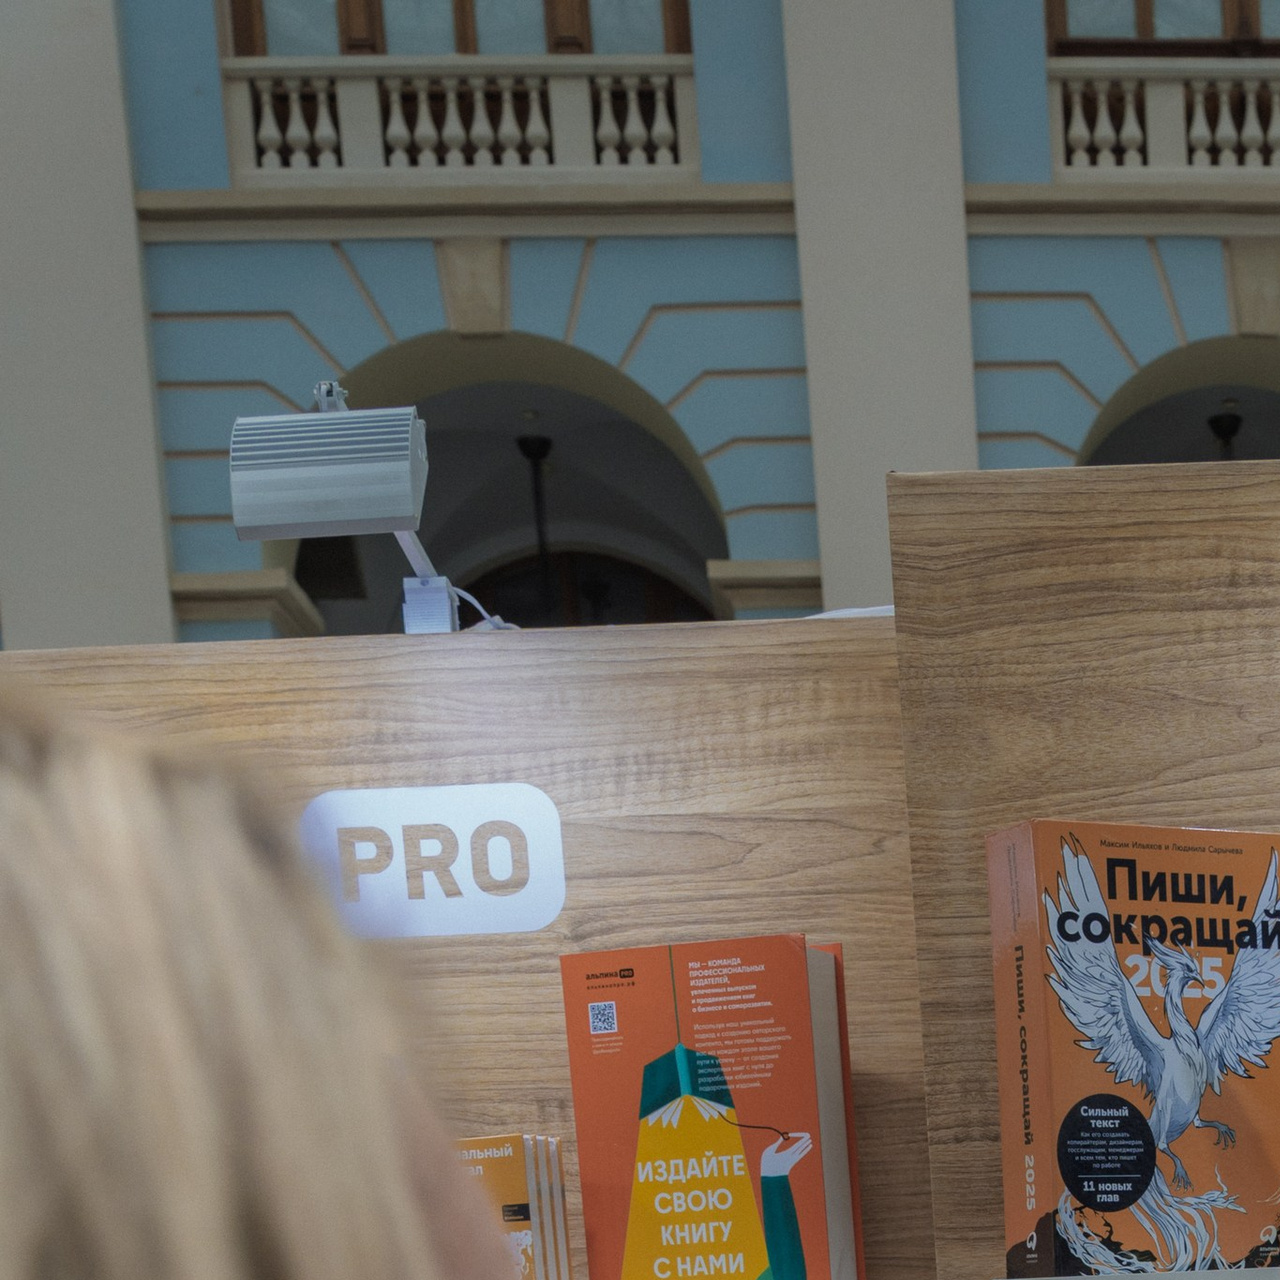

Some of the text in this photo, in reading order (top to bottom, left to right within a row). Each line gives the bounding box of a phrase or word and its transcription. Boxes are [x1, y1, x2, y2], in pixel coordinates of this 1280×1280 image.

[1100, 839, 1129, 848] Максим
[1132, 841, 1162, 850] Ильяхов
[1172, 844, 1206, 853] Людмила
[1208, 846, 1243, 856] Сарычева
[337, 820, 531, 902] PRO
[1106, 858, 1247, 911] Пиши,
[1014, 945, 1025, 1020] Пиши,
[1019, 1025, 1034, 1145] сокращай
[1080, 1106, 1129, 1116] Сильный
[1090, 1120, 1120, 1128] текст
[637, 1151, 745, 1184] ИЗДАЙТЕ
[1025, 1155, 1036, 1210] 2025
[1083, 1181, 1132, 1191] 11 новых
[654, 1188, 732, 1214] СВОЮ
[1096, 1194, 1120, 1202] глав
[661, 1221, 732, 1246] КНИГУ
[654, 1253, 744, 1278] С НАМИ
